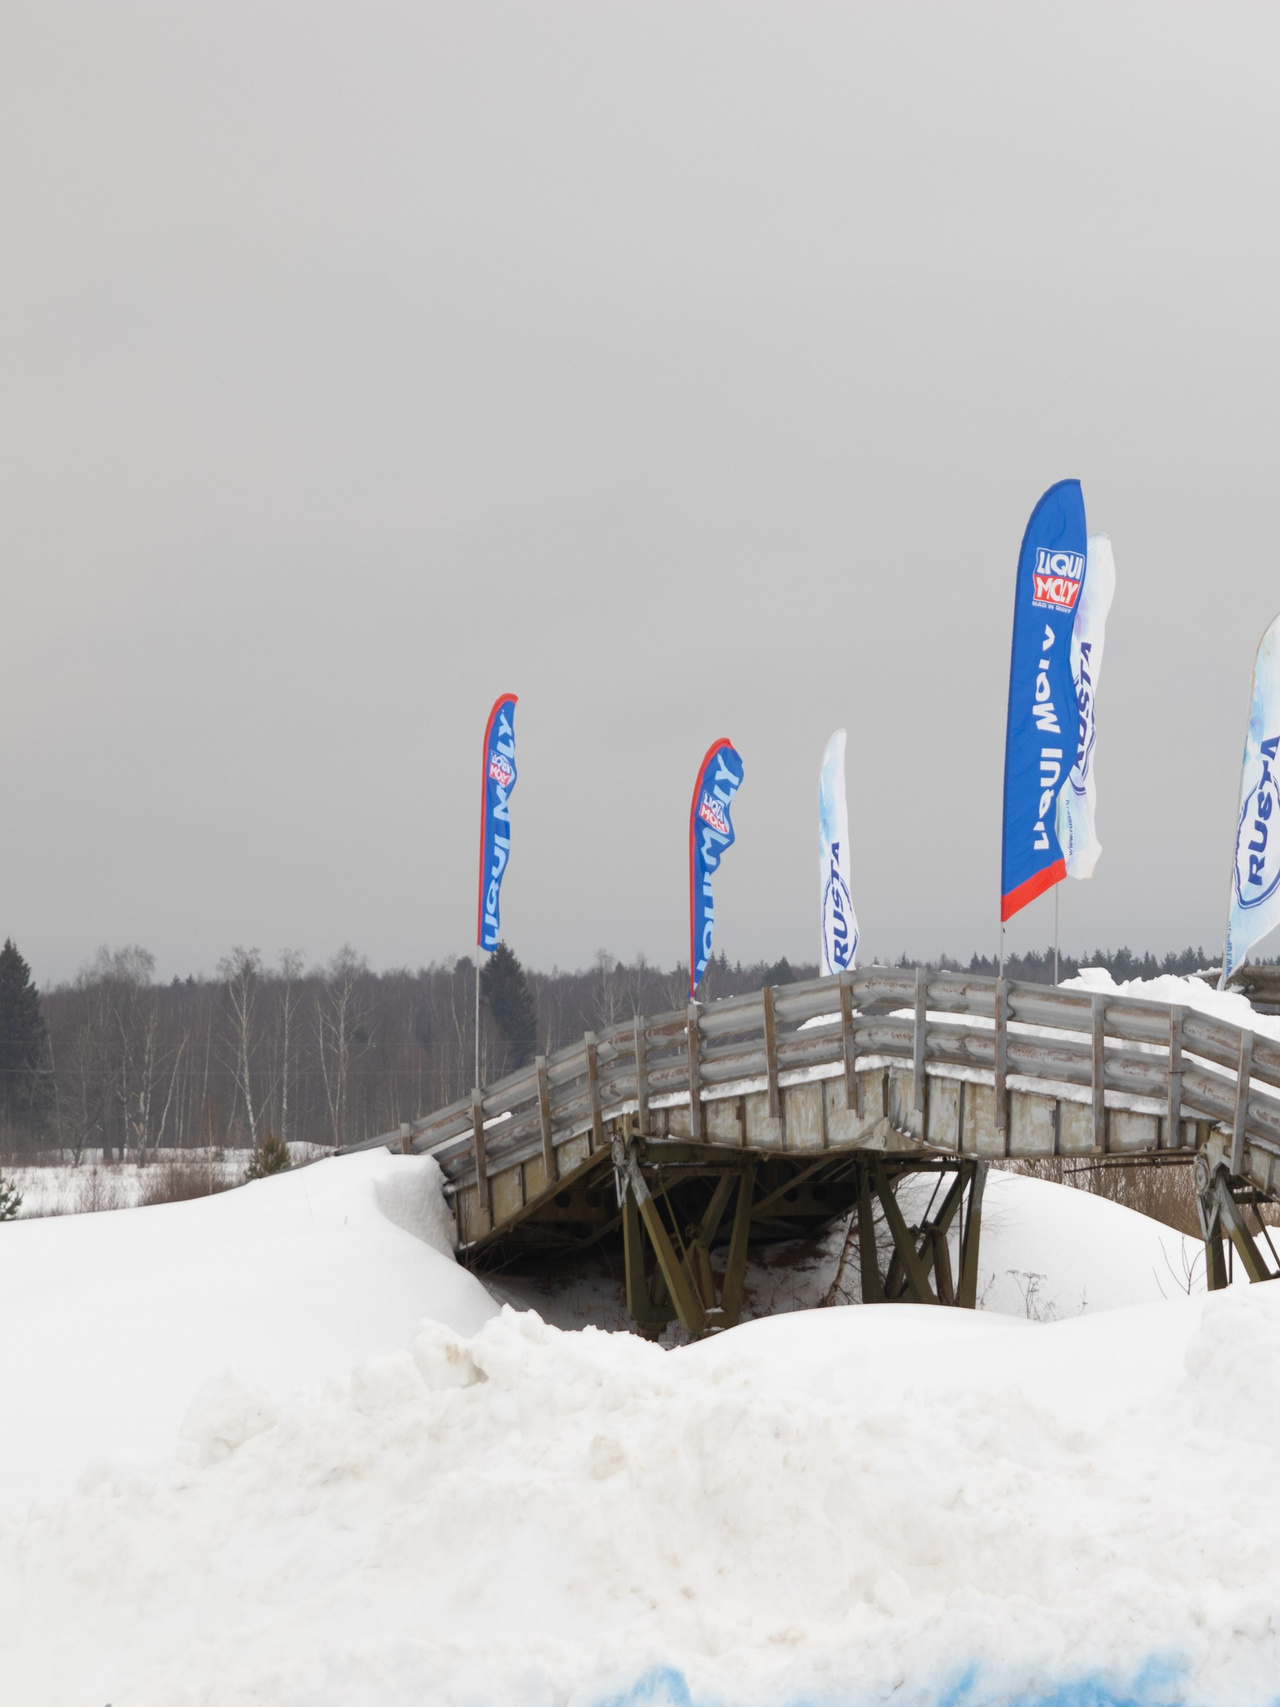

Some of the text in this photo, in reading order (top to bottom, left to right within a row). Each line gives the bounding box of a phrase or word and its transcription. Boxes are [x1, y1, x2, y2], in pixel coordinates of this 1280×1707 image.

[1036, 576, 1079, 604] MOLY
[1037, 551, 1084, 580] LIQUI
[1034, 748, 1062, 850] LIQUI
[1248, 736, 1280, 885] RUSTA
[485, 834, 510, 945] LIQUI
[694, 871, 713, 990] IQUI
[830, 842, 848, 968] RUSTA
